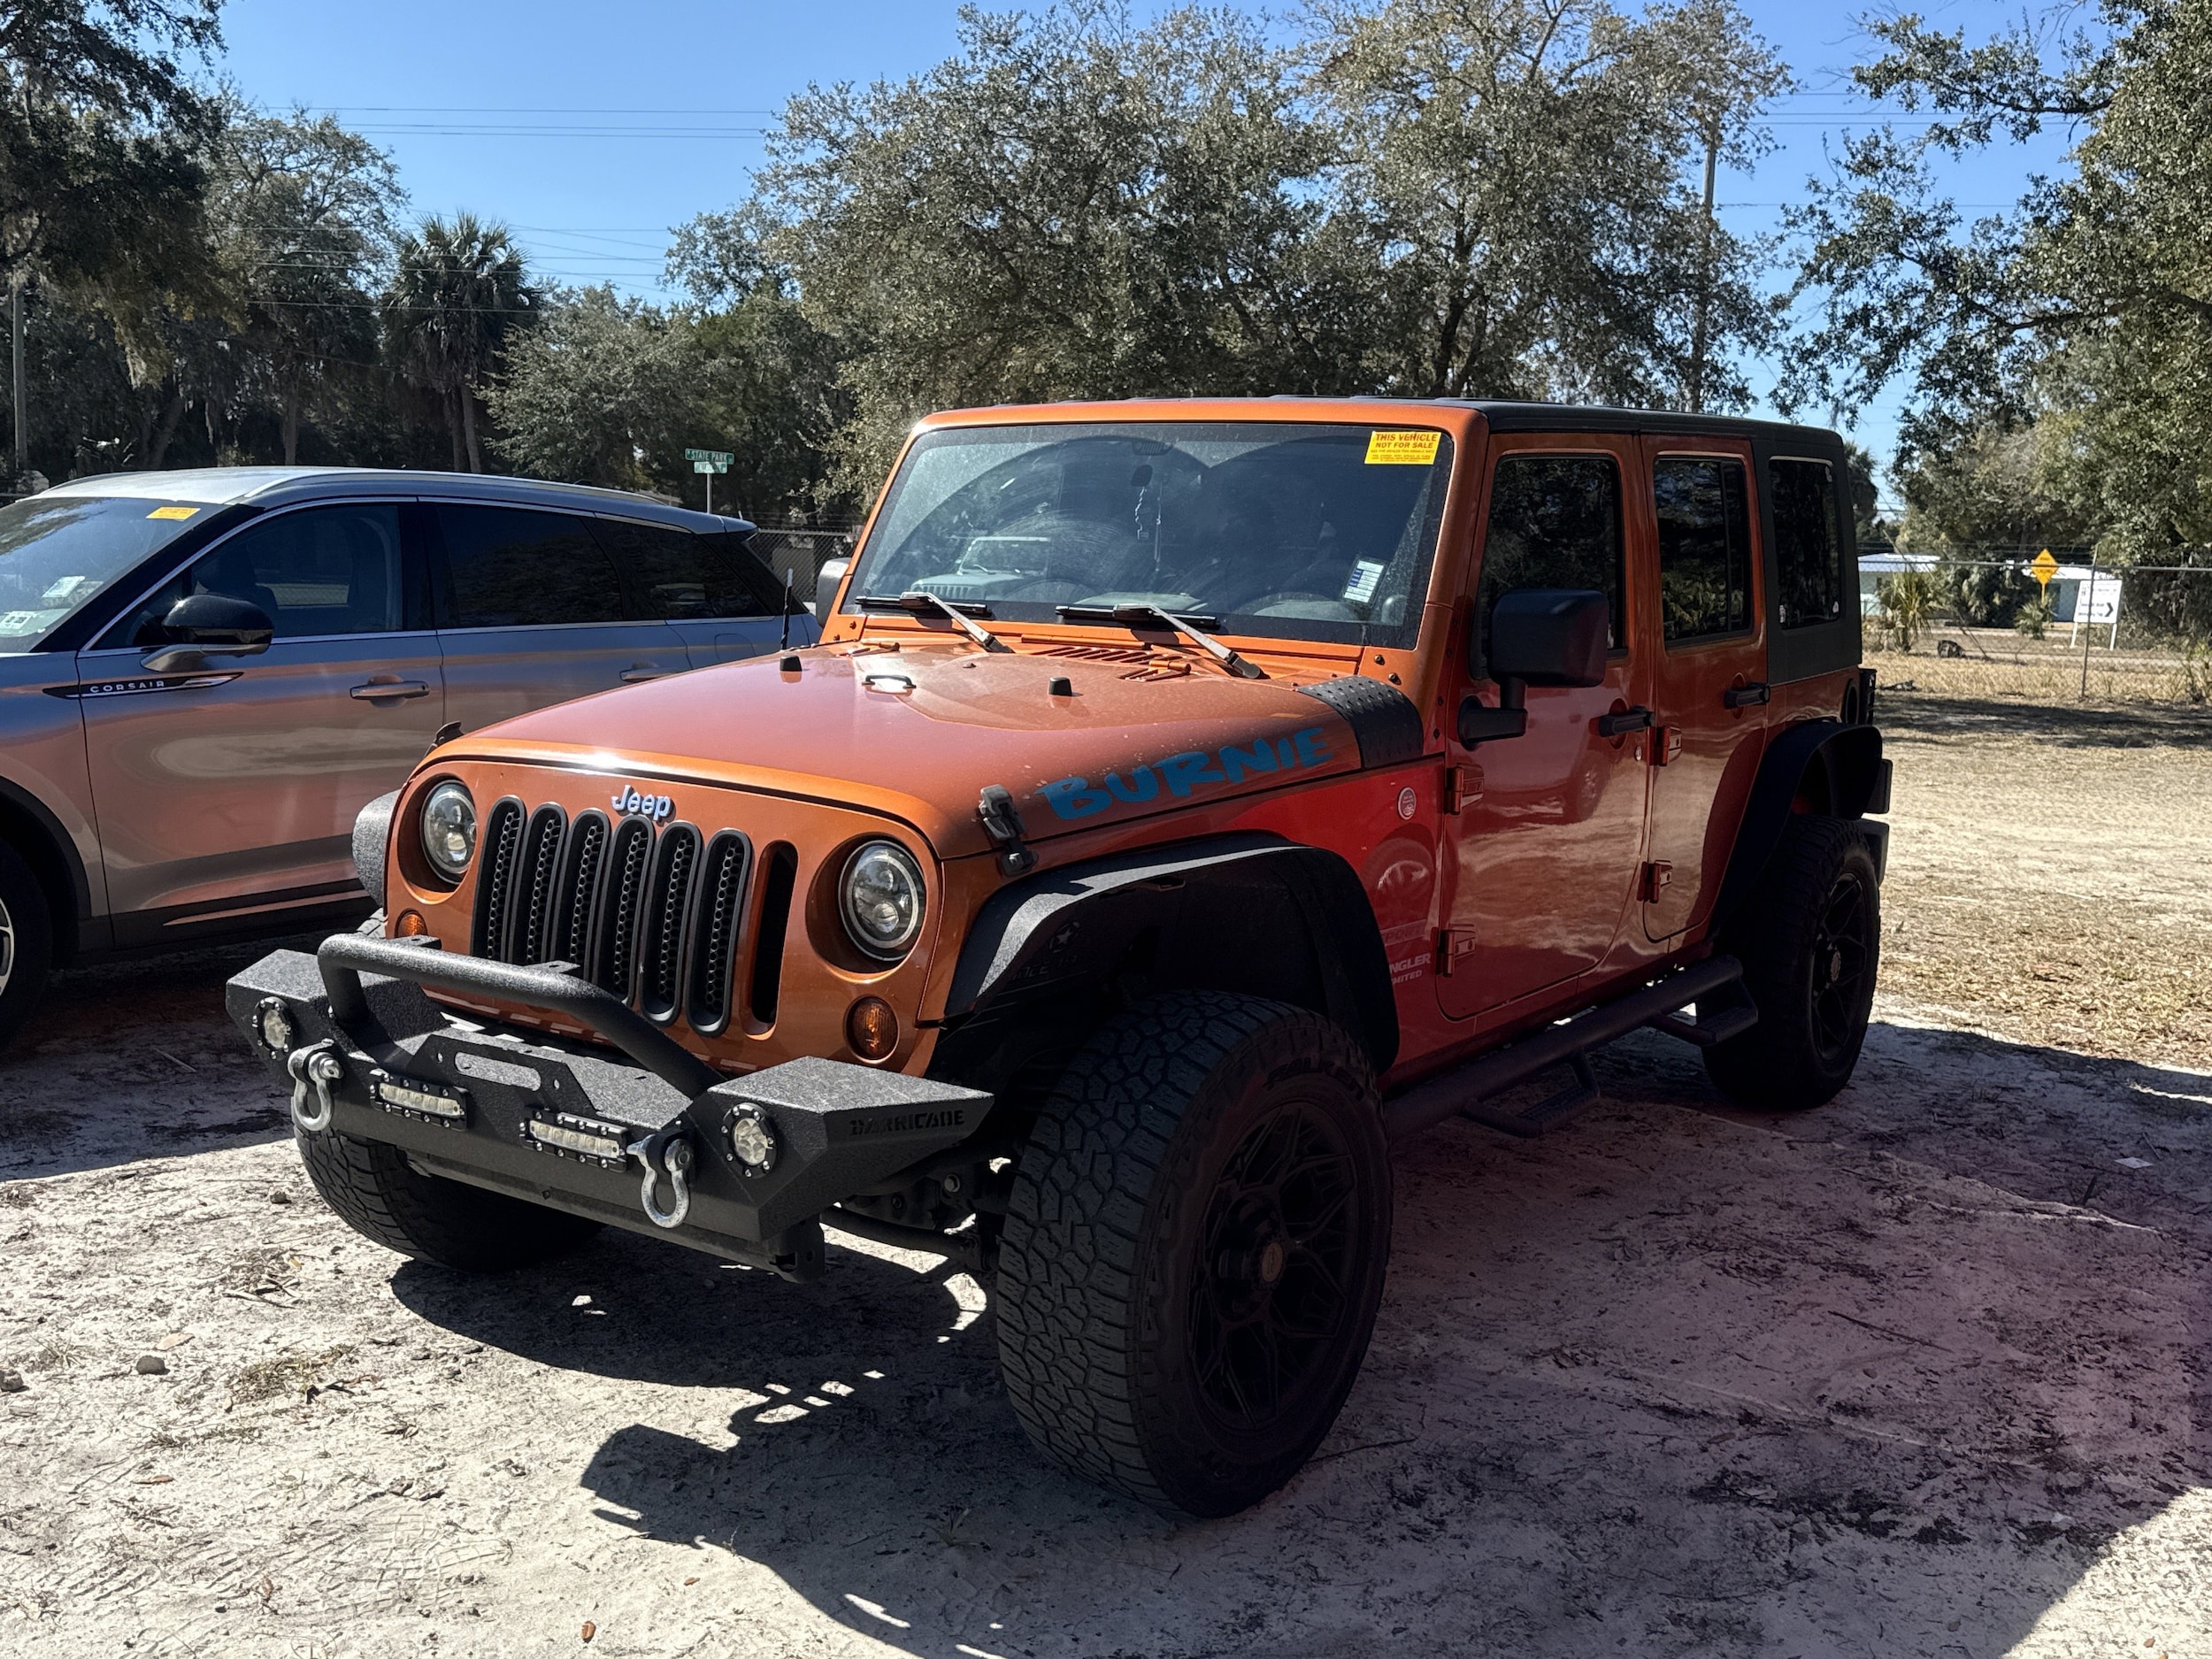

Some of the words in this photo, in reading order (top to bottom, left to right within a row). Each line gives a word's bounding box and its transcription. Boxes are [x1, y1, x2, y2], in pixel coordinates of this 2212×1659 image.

[691, 450, 710, 461] STATE
[711, 452, 727, 462] PARK
[89, 680, 165, 694] CORSAIR
[1033, 727, 1333, 820] BURNIE
[611, 784, 672, 821] Jeep
[1388, 952, 1431, 974] NGLER
[1391, 969, 1423, 985] MITED
[849, 1110, 965, 1136] BARRICADE
